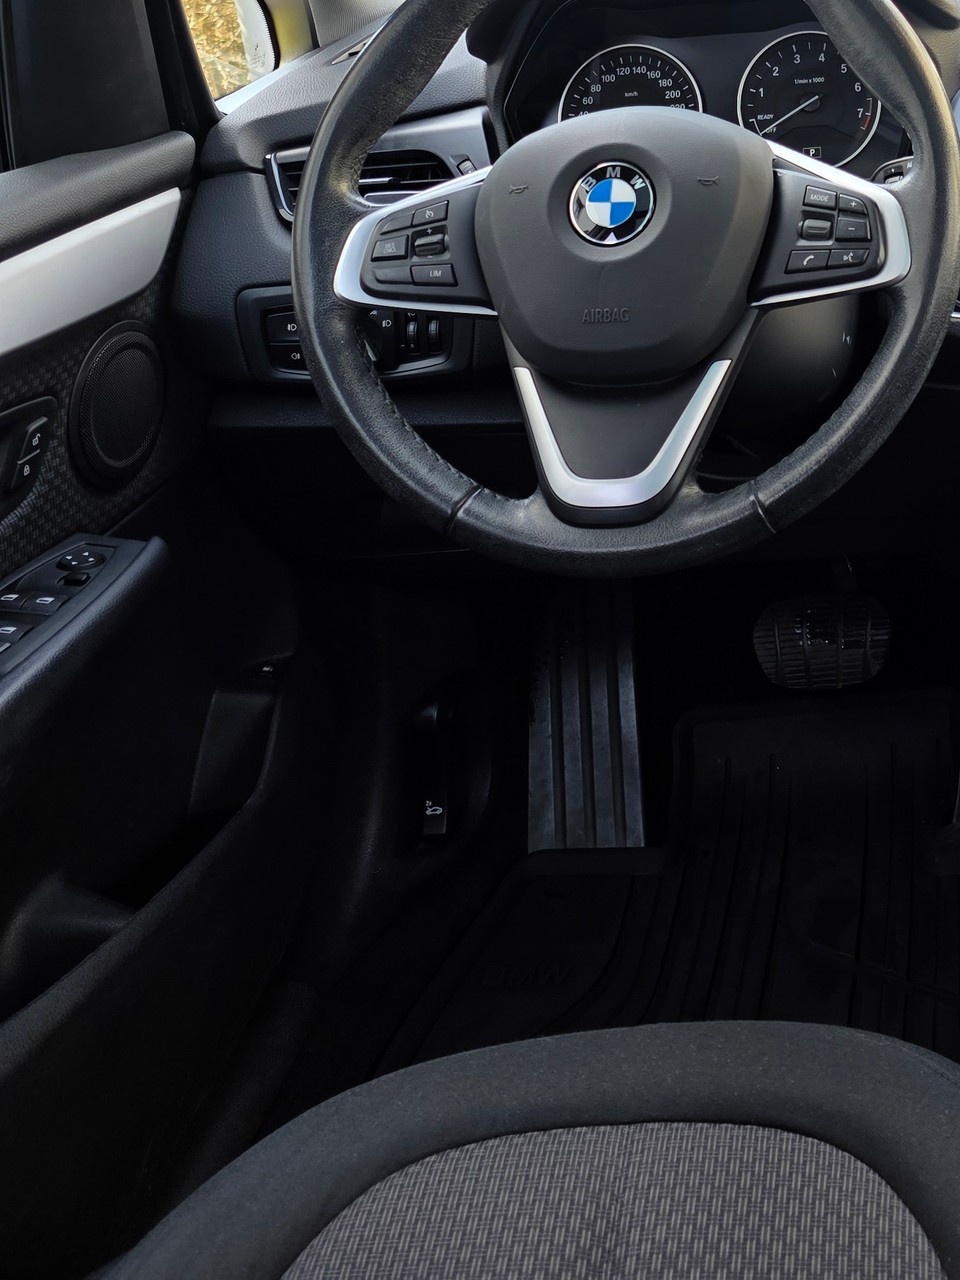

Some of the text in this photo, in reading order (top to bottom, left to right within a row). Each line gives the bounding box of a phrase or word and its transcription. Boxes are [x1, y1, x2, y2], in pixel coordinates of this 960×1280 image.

[793, 54, 801, 64] 3
[818, 52, 826, 62] 4
[616, 67, 631, 76] 120
[632, 65, 647, 74] 140
[772, 66, 780, 76] 2
[840, 63, 848, 73] 5
[601, 74, 616, 83] 100
[646, 70, 661, 79] 160
[658, 79, 673, 88] 180
[854, 82, 862, 92] 6
[590, 84, 601, 93] 80
[758, 87, 764, 97] 1
[665, 90, 681, 99] 200
[582, 96, 593, 105] 60
[856, 108, 864, 118] 7
[581, 166, 646, 192] BMW
[810, 194, 830, 202] MODE
[581, 307, 630, 324] AIRBAG
